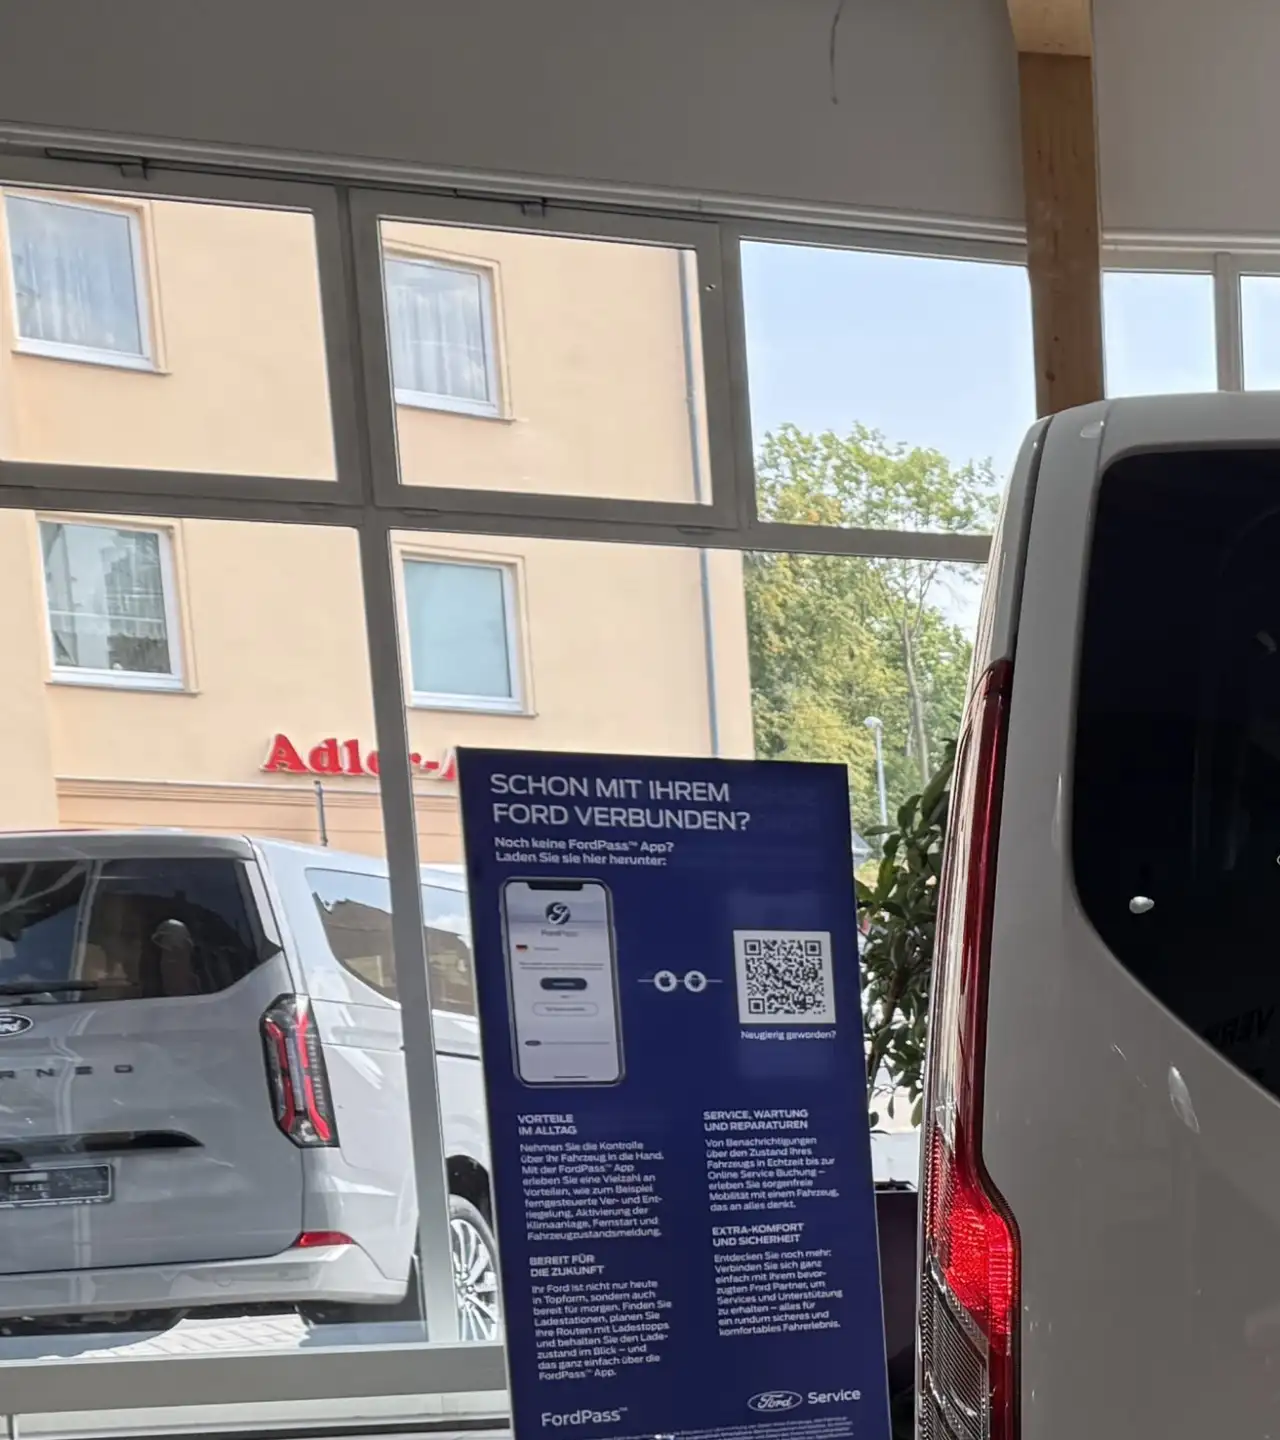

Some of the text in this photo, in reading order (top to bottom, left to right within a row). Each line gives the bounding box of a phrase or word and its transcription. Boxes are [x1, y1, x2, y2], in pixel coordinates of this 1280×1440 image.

[490, 773, 729, 802] SCHON MIT IHREM
[493, 803, 750, 830] FORD VERBUNDEN?
[495, 837, 530, 848] Noch
[532, 838, 566, 850] keine
[640, 841, 674, 853] App?
[496, 852, 666, 866] Laden Sie sie hier herunter:
[741, 1030, 836, 1040] Neugierig geworden?
[517, 1114, 573, 1124] VORTEILE
[754, 1109, 808, 1118] WARTUNG
[519, 1126, 577, 1135] IM ALLTAG
[704, 1120, 808, 1131] UND REPARATUREN
[520, 1141, 644, 1152] Nehmen Sie die Kontrolle
[705, 1136, 817, 1147] Von Benachrichtigungen
[521, 1155, 543, 1163] über
[561, 1153, 606, 1163] Fahrzeug
[619, 1152, 634, 1160] die
[635, 1151, 664, 1160] Hand.
[707, 1147, 812, 1158] über den Zustand Ihres
[522, 1166, 538, 1174] Mit
[614, 1164, 634, 1172] App
[707, 1160, 755, 1169] Fahrzeugs
[757, 1158, 765, 1167] in
[767, 1158, 804, 1167] Echtzeit
[806, 1157, 819, 1165] bis
[708, 1168, 816, 1179] Online Service Buchung
[523, 1177, 560, 1185] erleben
[562, 1176, 578, 1184] Sie
[602, 1175, 640, 1183] Vielzahl
[573, 1187, 590, 1195] wie
[616, 1184, 653, 1193] Beispiel
[710, 1203, 728, 1211] das
[744, 1201, 765, 1210] alles
[767, 1200, 796, 1209] denkt.
[593, 1219, 638, 1227] Fernstart
[640, 1217, 658, 1225] und
[712, 1223, 804, 1236] EXTRA-KOMFORT
[713, 1234, 800, 1246] UND SICHERHEIT
[529, 1254, 595, 1266] BEREIT FÜR
[714, 1249, 831, 1262] Entdecken Sie noch mehr:
[530, 1265, 604, 1277] DIE ZUKUNFT
[715, 1260, 822, 1273] Verbinden Sie sich ganz
[547, 1284, 569, 1292] Ford
[586, 1283, 610, 1291] nicht
[630, 1280, 658, 1288] heute
[544, 1295, 588, 1304] Topform,
[590, 1292, 629, 1301] sondern
[632, 1291, 655, 1299] auch
[718, 1290, 843, 1305] Services und Unterstützung
[533, 1307, 562, 1315] bereit
[564, 1305, 577, 1313] für
[622, 1302, 655, 1310] Finden
[731, 1306, 768, 1314] erhalten
[779, 1302, 800, 1310] alles
[803, 1301, 815, 1309] für
[735, 1316, 770, 1324] rundum
[773, 1313, 809, 1322] sicheres
[719, 1320, 840, 1336] komfortables Fahrerlebnis.
[537, 1333, 668, 1348] und behalten Sie den Lade-
[559, 1360, 582, 1370] ganz
[584, 1357, 619, 1366] einfach
[622, 1355, 644, 1364] über
[646, 1354, 660, 1362] die
[595, 1369, 616, 1378] App.
[757, 1389, 861, 1409] Ford Service
